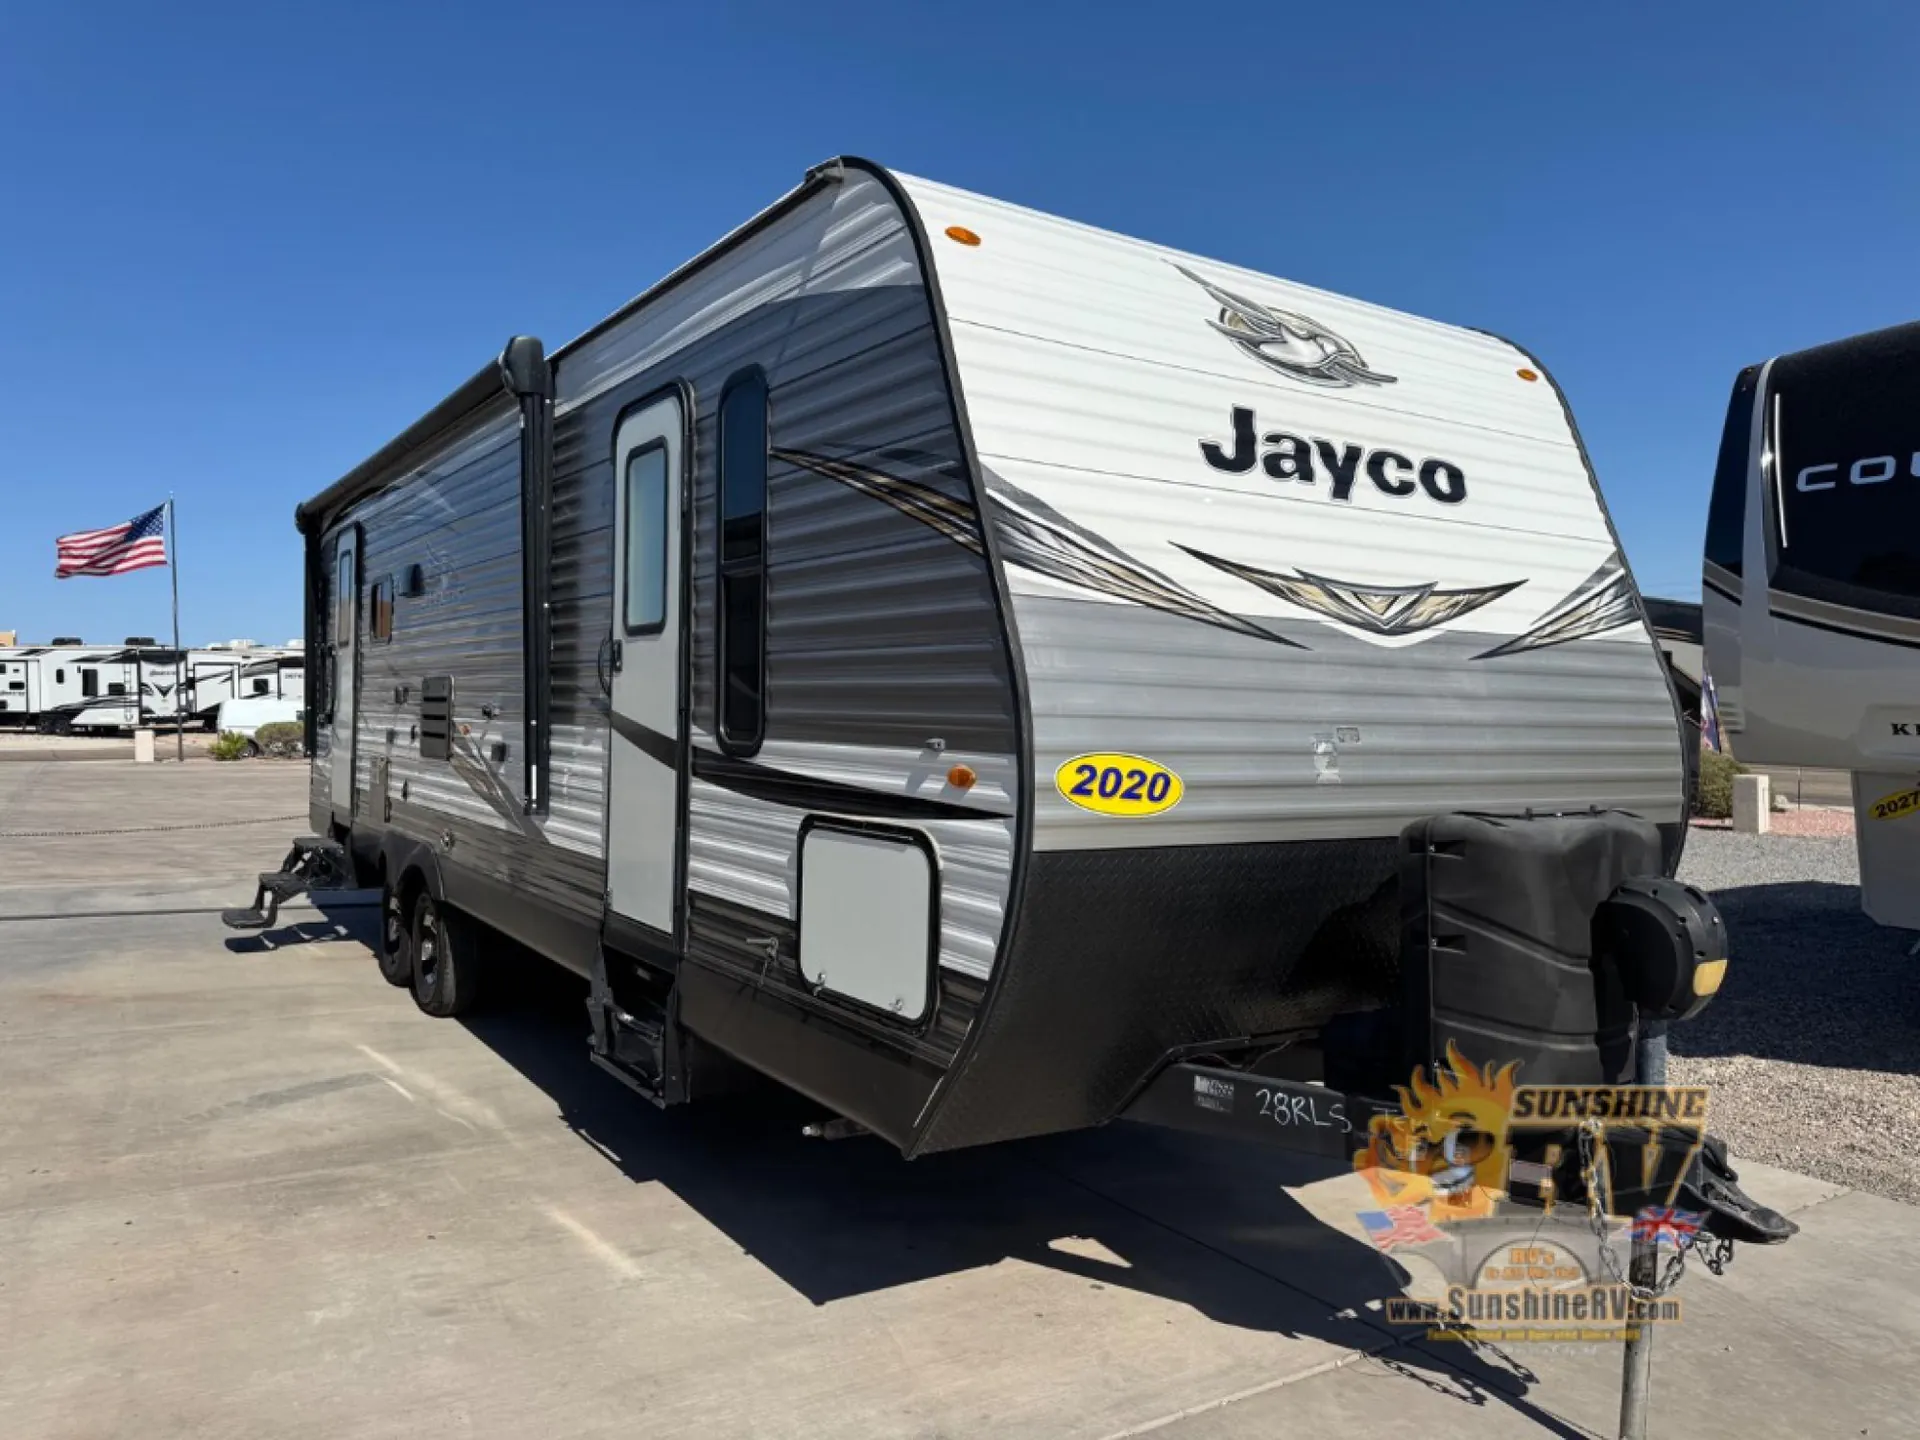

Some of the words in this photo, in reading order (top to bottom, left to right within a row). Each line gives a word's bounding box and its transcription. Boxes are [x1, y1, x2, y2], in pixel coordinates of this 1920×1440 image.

[1199, 403, 1467, 503] Jayco
[1796, 452, 1920, 492] CO
[1070, 764, 1171, 802] 2020
[1255, 1088, 1353, 1133] 28RLS
